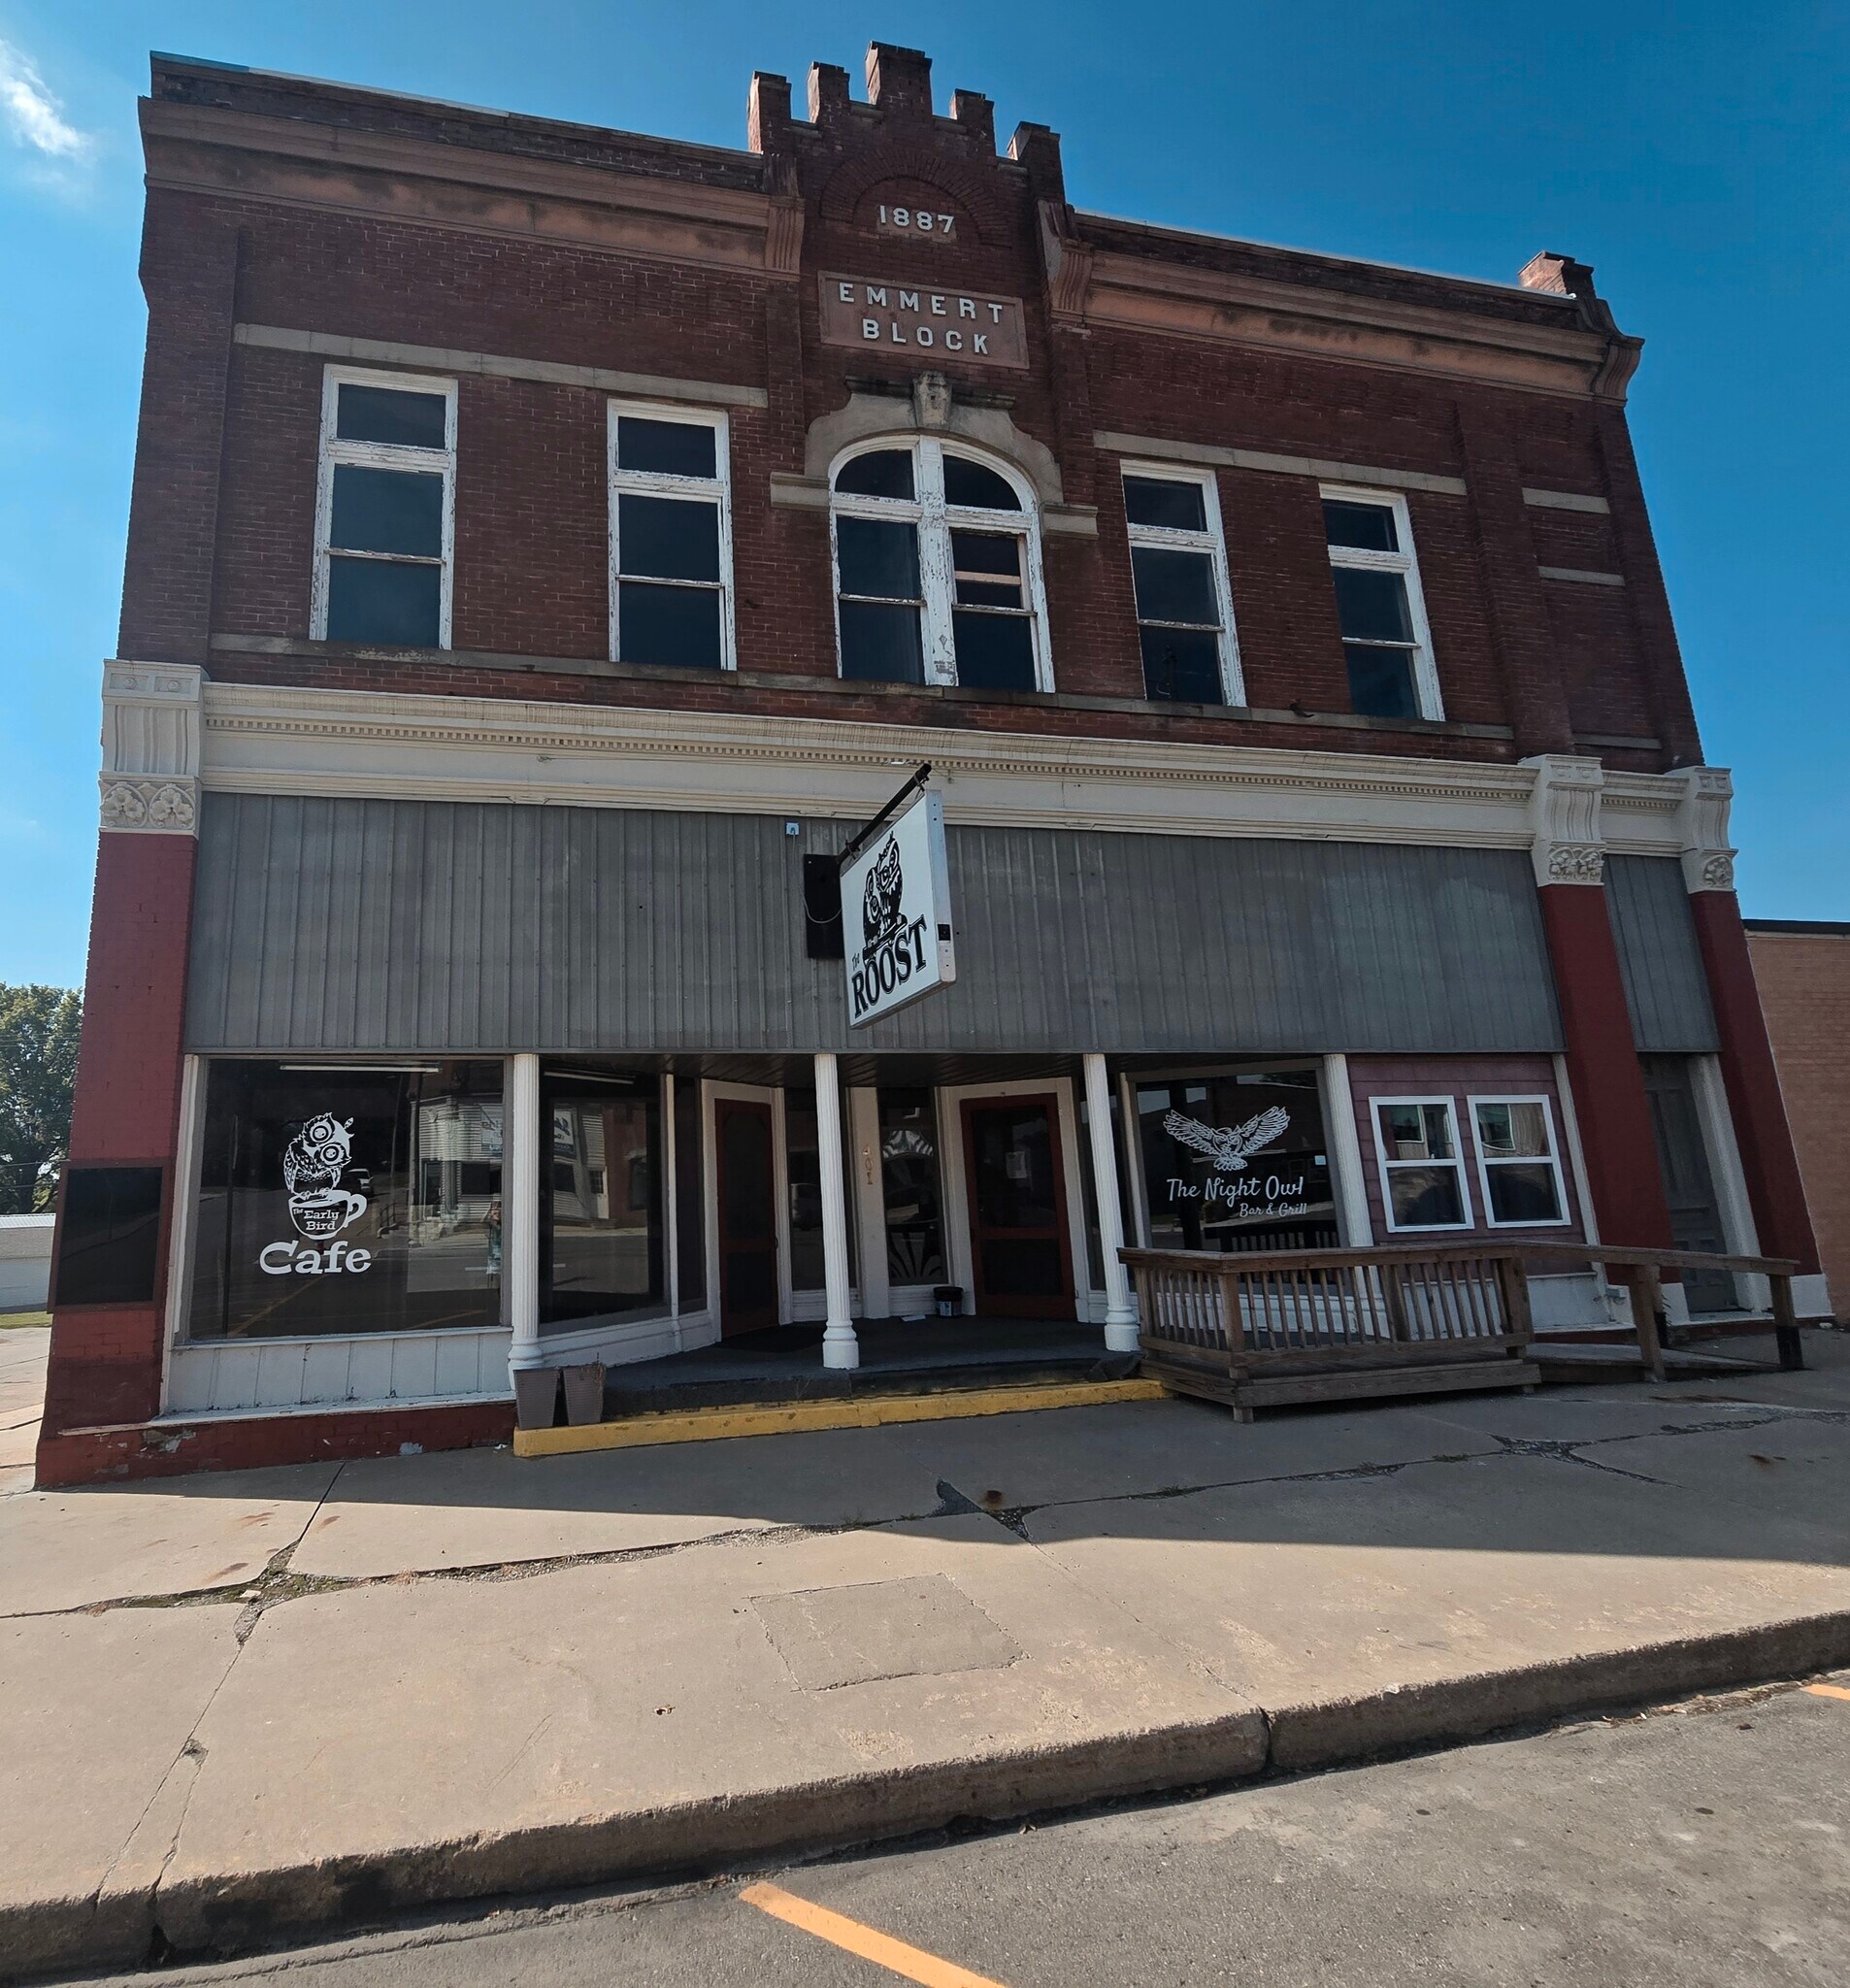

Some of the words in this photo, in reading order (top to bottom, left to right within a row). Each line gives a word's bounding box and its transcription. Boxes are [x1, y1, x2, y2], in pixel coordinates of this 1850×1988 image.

[879, 205, 954, 234] 1887
[839, 282, 1003, 323] EMMERT
[862, 318, 988, 354] BLOCK
[851, 914, 927, 1019] ROOST
[862, 1143, 874, 1185] 401
[1167, 1178, 1201, 1201] The
[1205, 1176, 1261, 1208] Night
[1265, 1176, 1305, 1200] Owl
[303, 1209, 340, 1221] Early
[305, 1220, 336, 1231] Bird
[1239, 1203, 1264, 1217] Bar
[1266, 1203, 1274, 1215] &
[1278, 1203, 1307, 1216] Grill
[259, 1240, 372, 1275] Cafe
